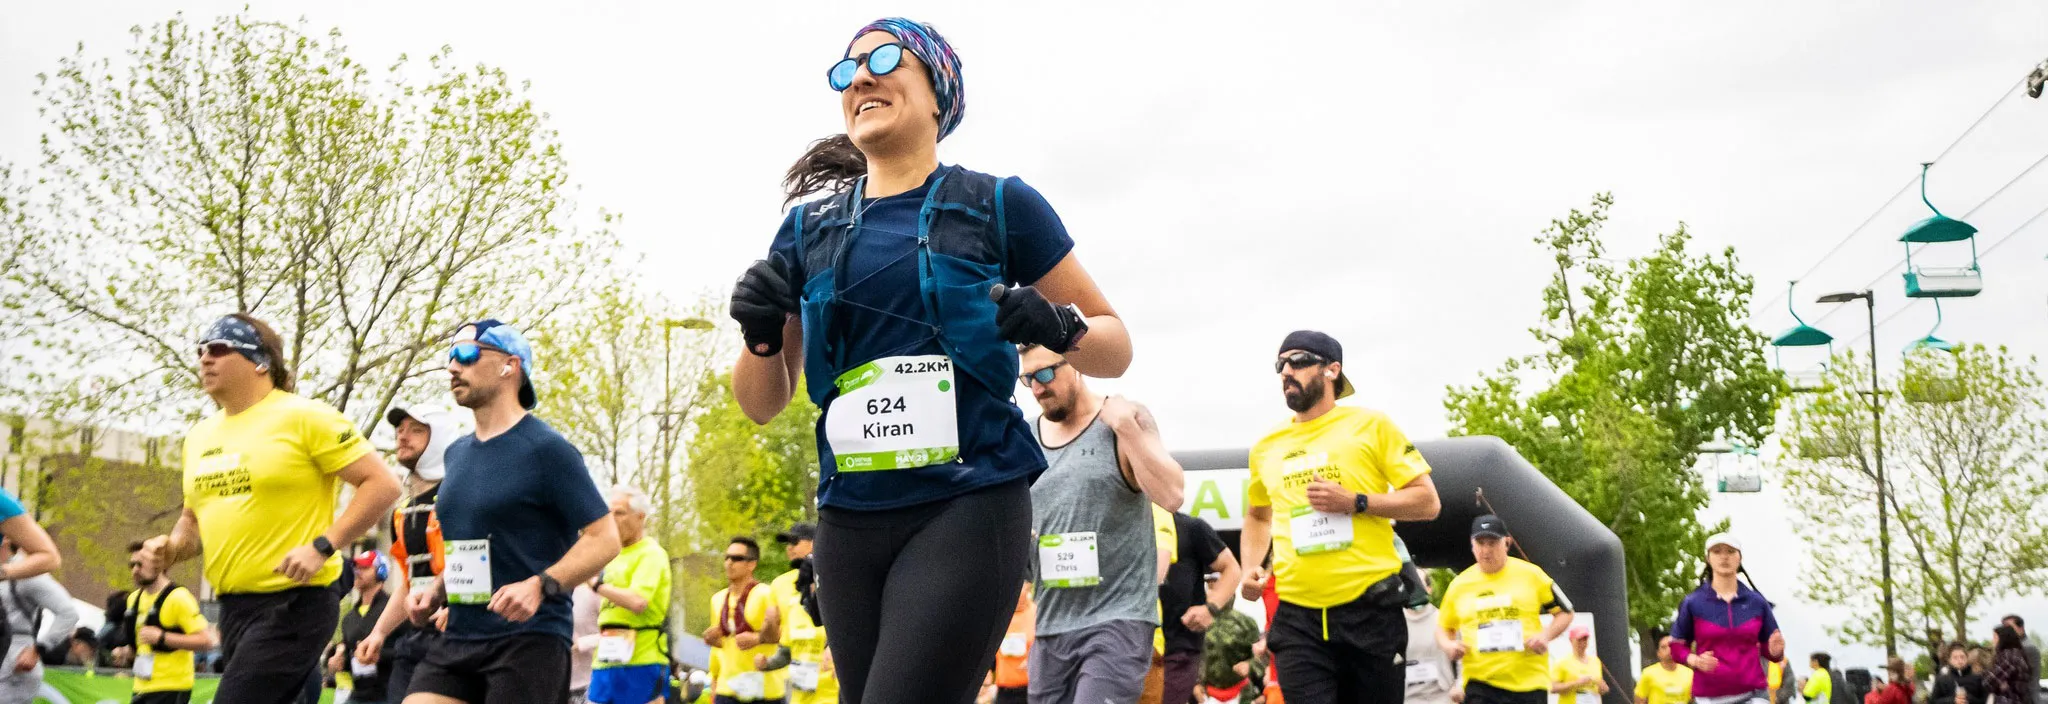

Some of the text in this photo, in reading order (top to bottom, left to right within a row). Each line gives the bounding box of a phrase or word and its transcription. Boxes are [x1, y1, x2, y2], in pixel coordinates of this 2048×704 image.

[894, 361, 950, 374] 42.2KM
[867, 396, 906, 415] 624
[863, 422, 914, 439] Kiran
[1283, 469, 1313, 481] WHERE
[1317, 463, 1339, 473] WILL
[1311, 516, 1329, 527] 291
[1057, 552, 1074, 561] 529
[1055, 564, 1078, 572] Chris
